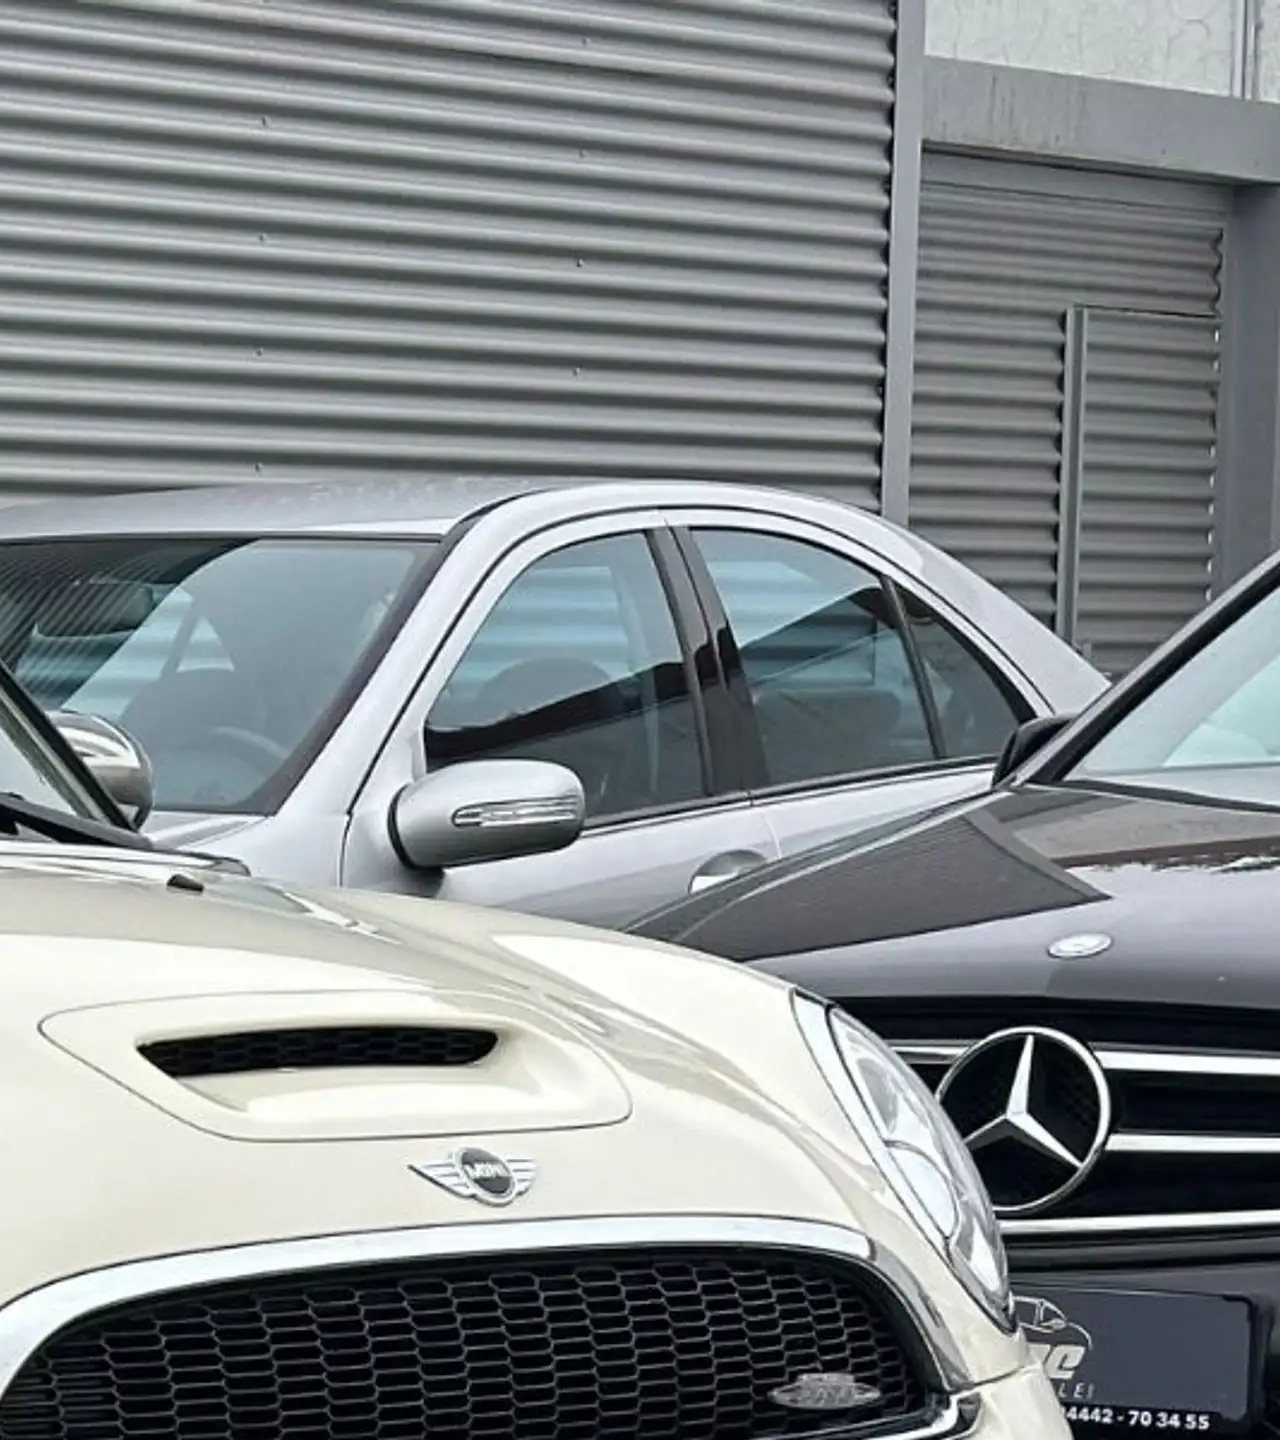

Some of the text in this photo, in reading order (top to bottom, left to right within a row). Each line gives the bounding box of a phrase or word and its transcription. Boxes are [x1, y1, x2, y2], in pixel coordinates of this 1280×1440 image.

[1128, 1410, 1152, 1427] 70
[1156, 1411, 1181, 1428] 34
[1184, 1413, 1210, 1430] 55
